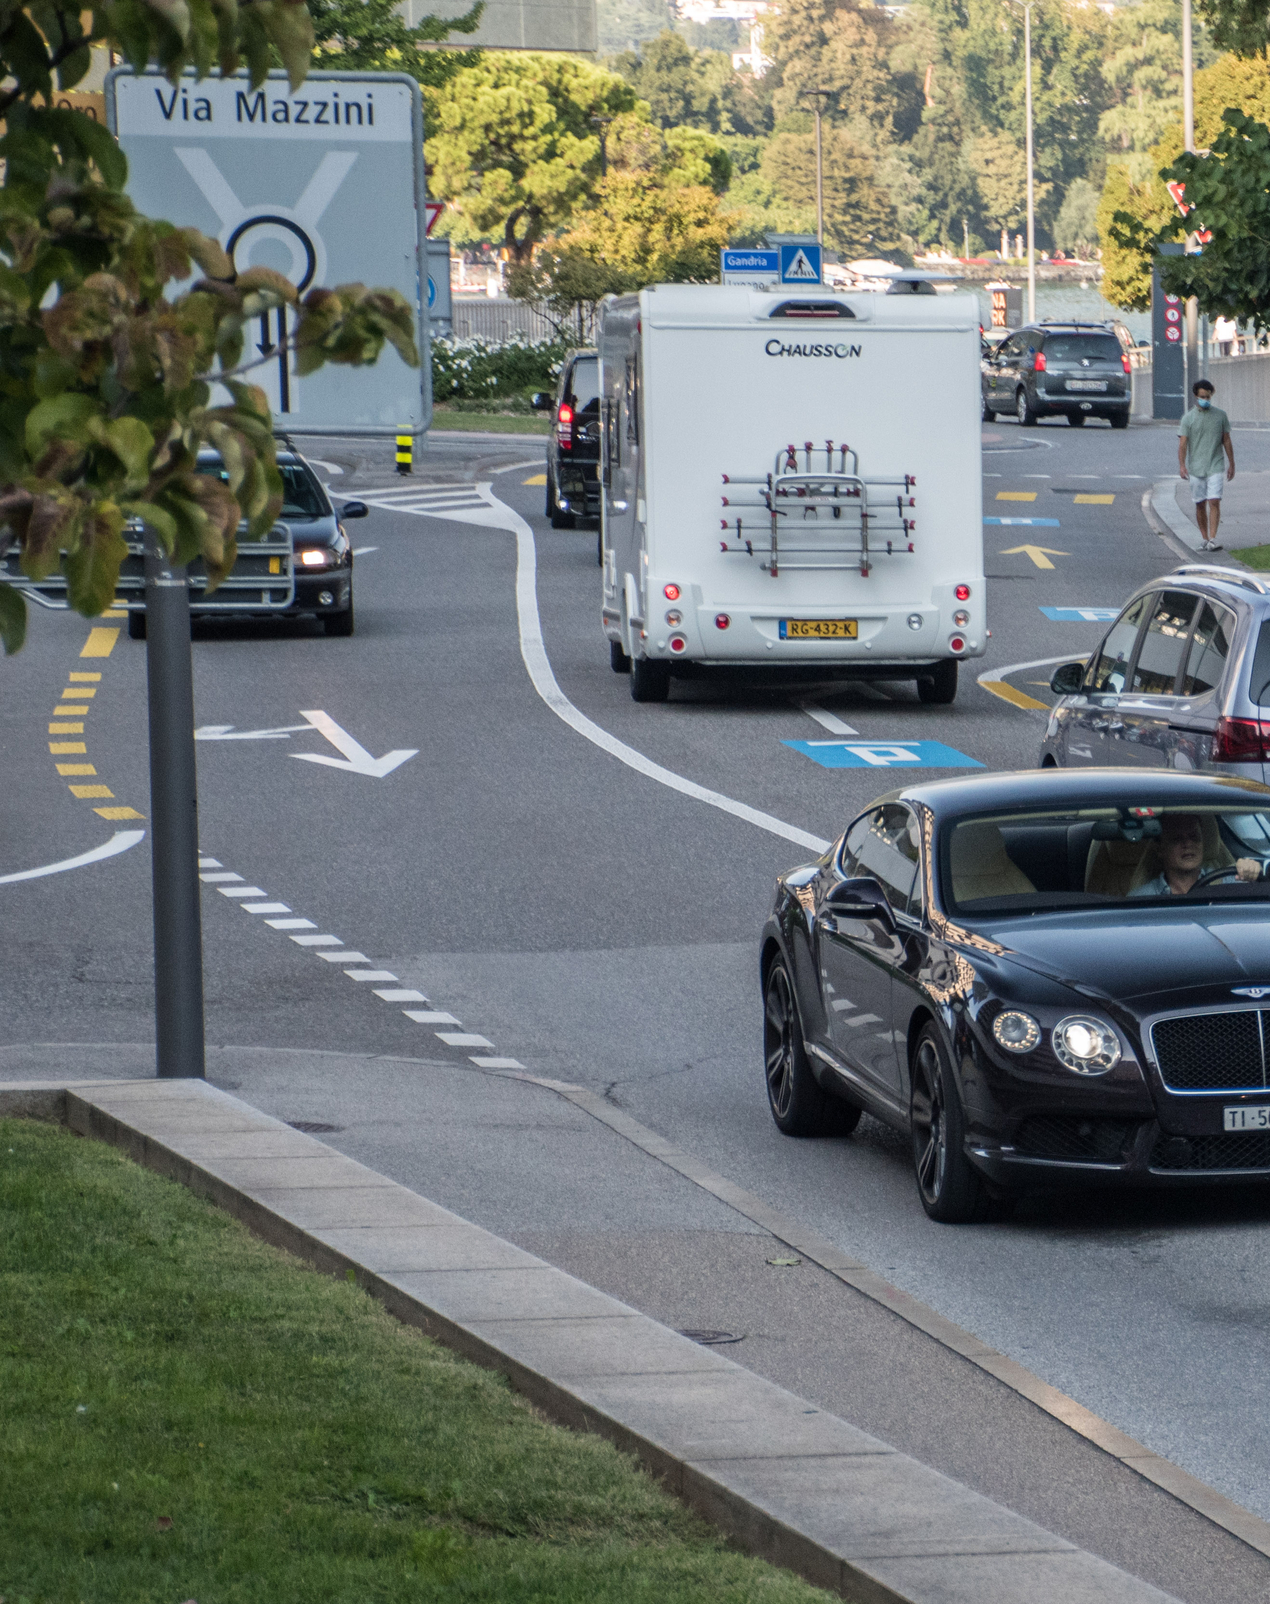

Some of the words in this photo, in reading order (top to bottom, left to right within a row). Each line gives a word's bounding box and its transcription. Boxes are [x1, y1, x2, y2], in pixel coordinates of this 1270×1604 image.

[154, 88, 212, 121] Via
[235, 91, 374, 126] Mazzini
[727, 255, 768, 267] Gandria
[791, 623, 852, 635] RG-432-K
